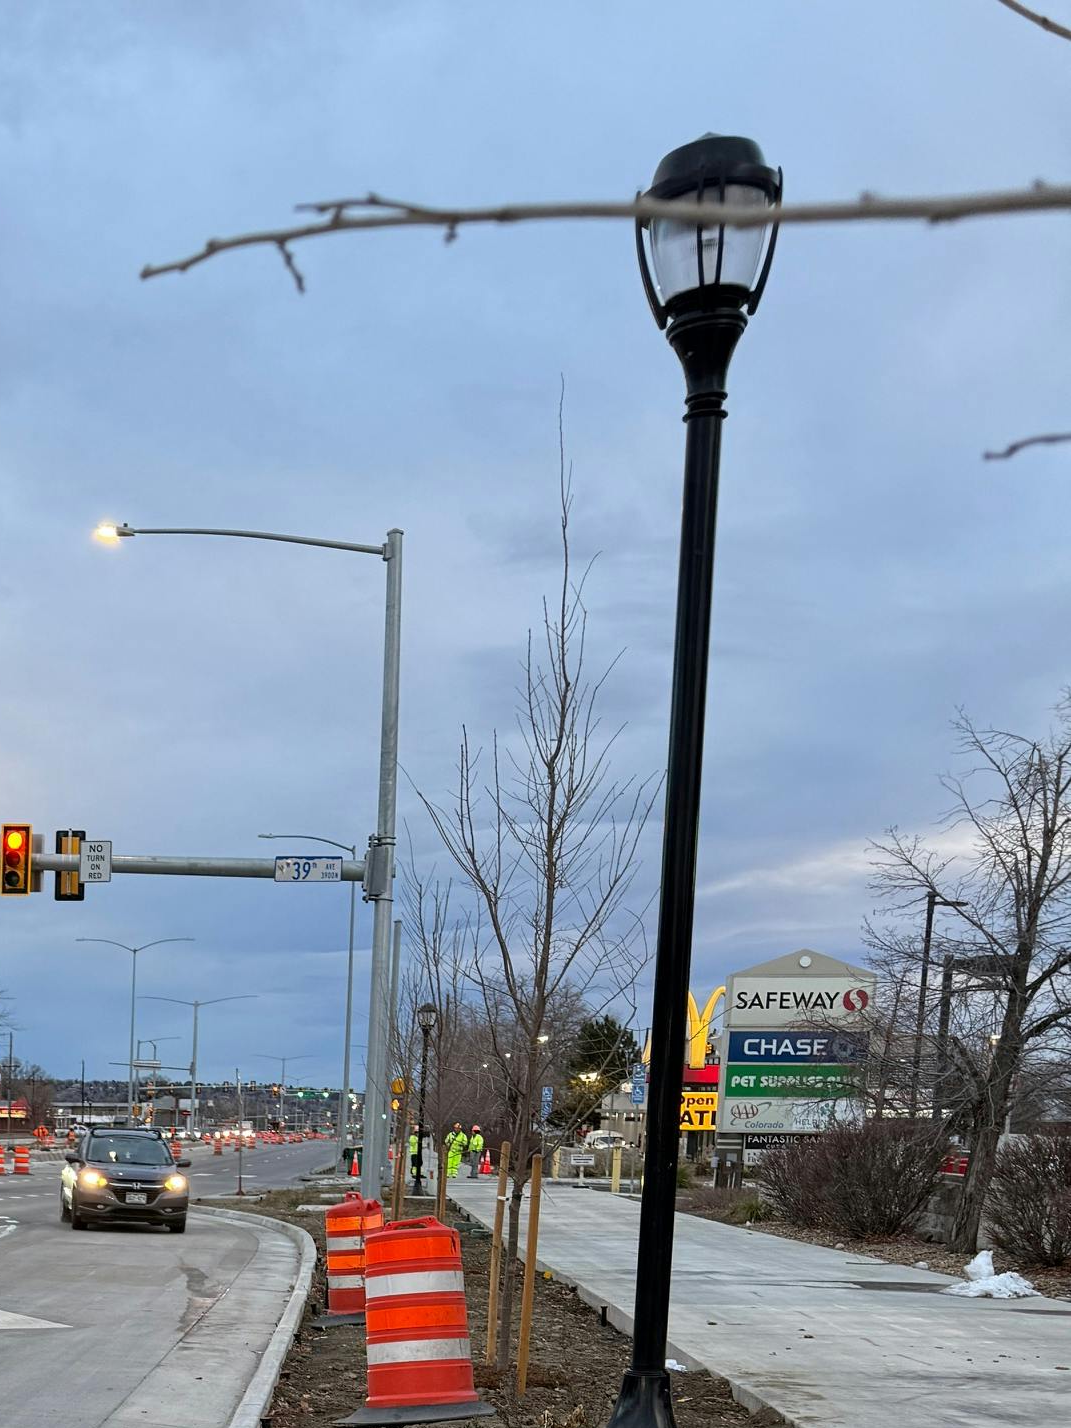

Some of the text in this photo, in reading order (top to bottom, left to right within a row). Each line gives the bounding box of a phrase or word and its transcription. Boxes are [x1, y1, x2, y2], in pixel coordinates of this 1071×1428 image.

[89, 844, 103, 853] NO
[326, 863, 336, 871] AVE
[88, 872, 102, 880] RED
[735, 991, 840, 1010] SAFEWAY
[743, 1038, 828, 1056] CHASE
[730, 1075, 757, 1088] PET
[744, 1121, 784, 1129] Colorado
[747, 1135, 800, 1144] FANTASTIC
